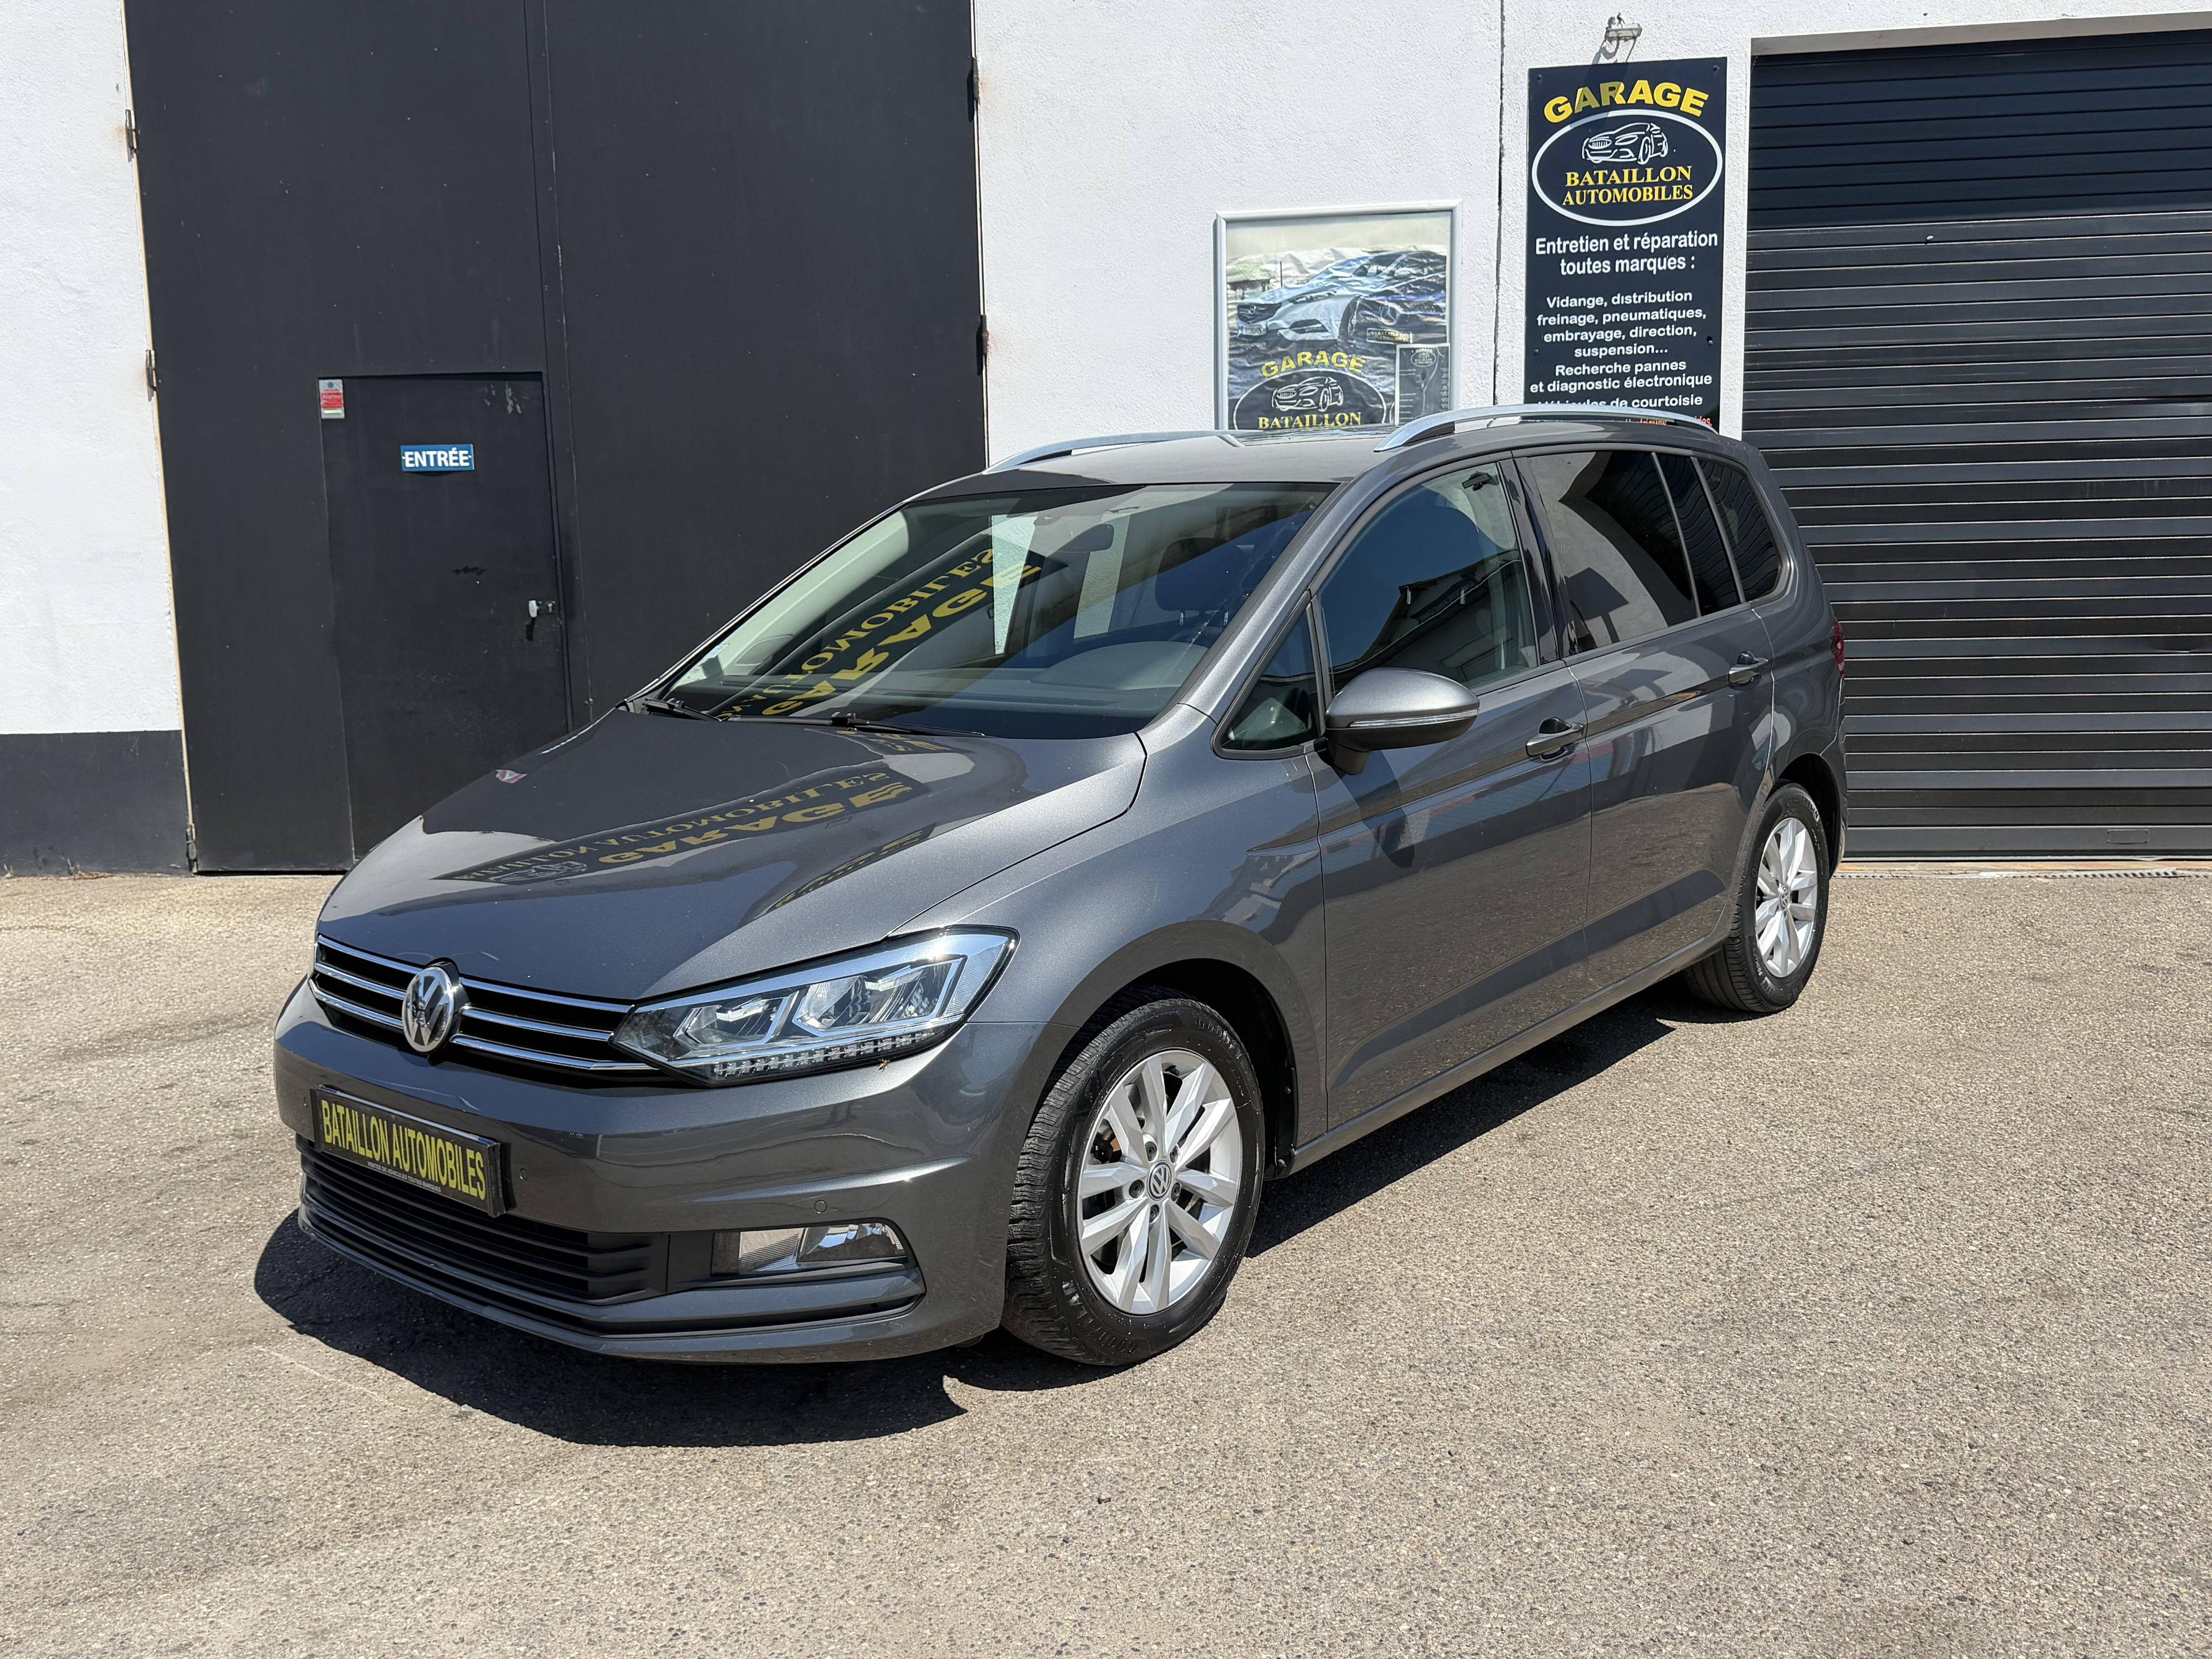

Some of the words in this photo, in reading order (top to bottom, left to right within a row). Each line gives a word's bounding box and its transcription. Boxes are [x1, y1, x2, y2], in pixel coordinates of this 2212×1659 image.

[1544, 80, 1709, 123] GARAGE
[1565, 166, 1692, 187] BATAILLON
[1562, 185, 1694, 206] AUTOMOBILES
[1536, 235, 1608, 255] Entretien
[1613, 234, 1630, 251] et
[1633, 230, 1718, 253] réparation
[1560, 257, 1611, 275] toutes
[1615, 256, 1686, 275] marques
[1546, 296, 1607, 309] Vidange,
[1611, 290, 1692, 305] distribution
[1536, 313, 1599, 327] freinage,
[1603, 308, 1706, 325] pneumatiques,
[1544, 329, 1626, 343] embrayage,
[1629, 324, 1697, 338] direction,
[1574, 343, 1668, 359] suspension...
[1261, 350, 1366, 378] GARAGE
[1555, 362, 1631, 377] Recherche
[1634, 361, 1687, 375] pannes
[1529, 381, 1544, 393] et
[1547, 377, 1620, 393] diagnostic
[1624, 373, 1713, 388] électronique
[1611, 397, 1628, 407] de
[1632, 394, 1703, 408] courtoisie
[1258, 412, 1361, 430] BATAILLON
[404, 447, 470, 467] ENTRÉE
[321, 1099, 390, 1165] BATAILLON
[392, 1123, 486, 1200] AUTOMOBILES
